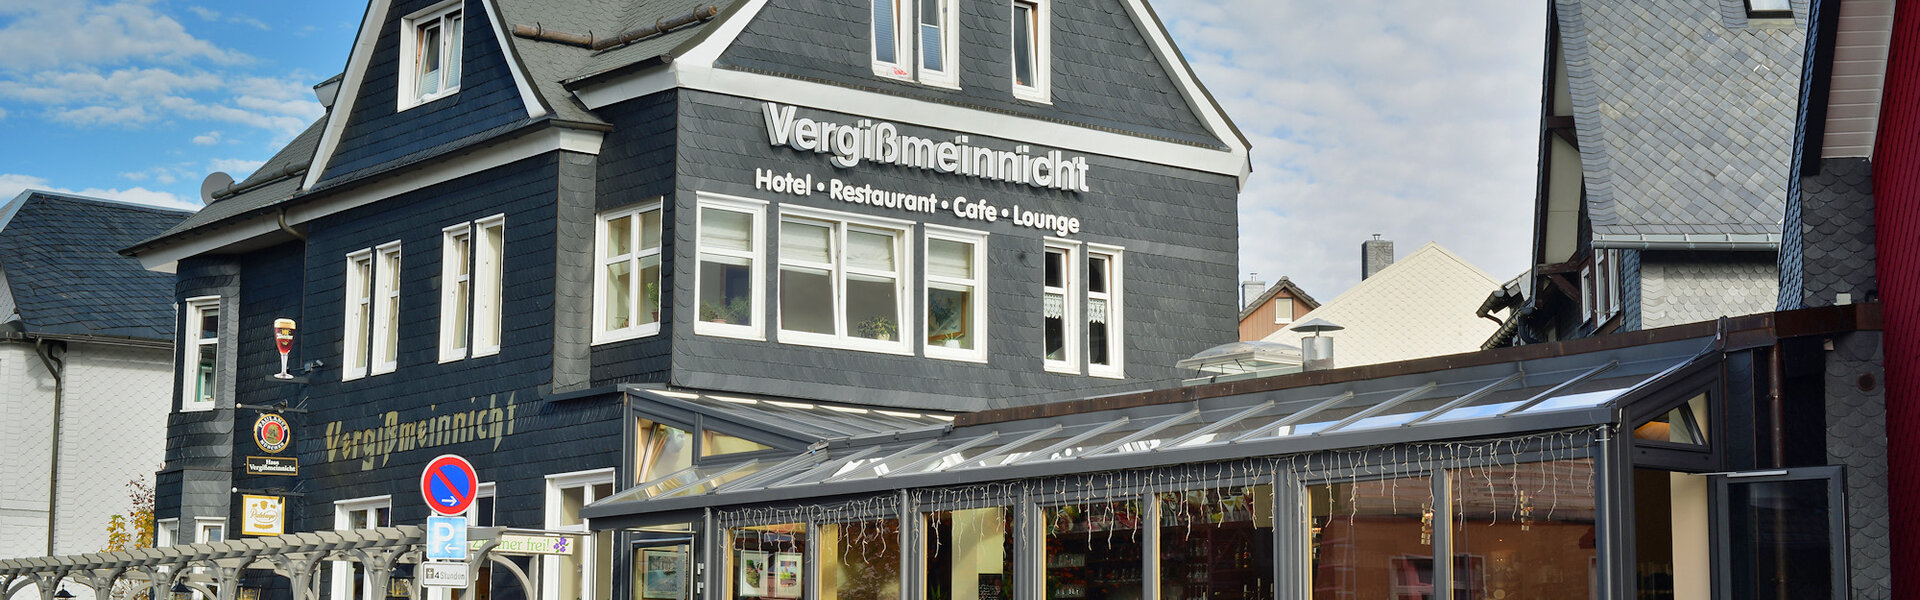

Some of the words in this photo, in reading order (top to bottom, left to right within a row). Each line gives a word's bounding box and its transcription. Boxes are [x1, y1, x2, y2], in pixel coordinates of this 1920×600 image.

[762, 102, 1090, 193] Vergißmeinnicht
[755, 168, 811, 196] Hotel
[829, 178, 937, 214] Restaurant
[952, 196, 997, 222] Cafe
[1013, 205, 1080, 236] Lounge
[258, 416, 287, 431] PAULANER
[325, 391, 517, 471] Vergißmeinnicht
[433, 522, 455, 553] P
[526, 538, 550, 551] frei!
[440, 570, 466, 580] Stunden
